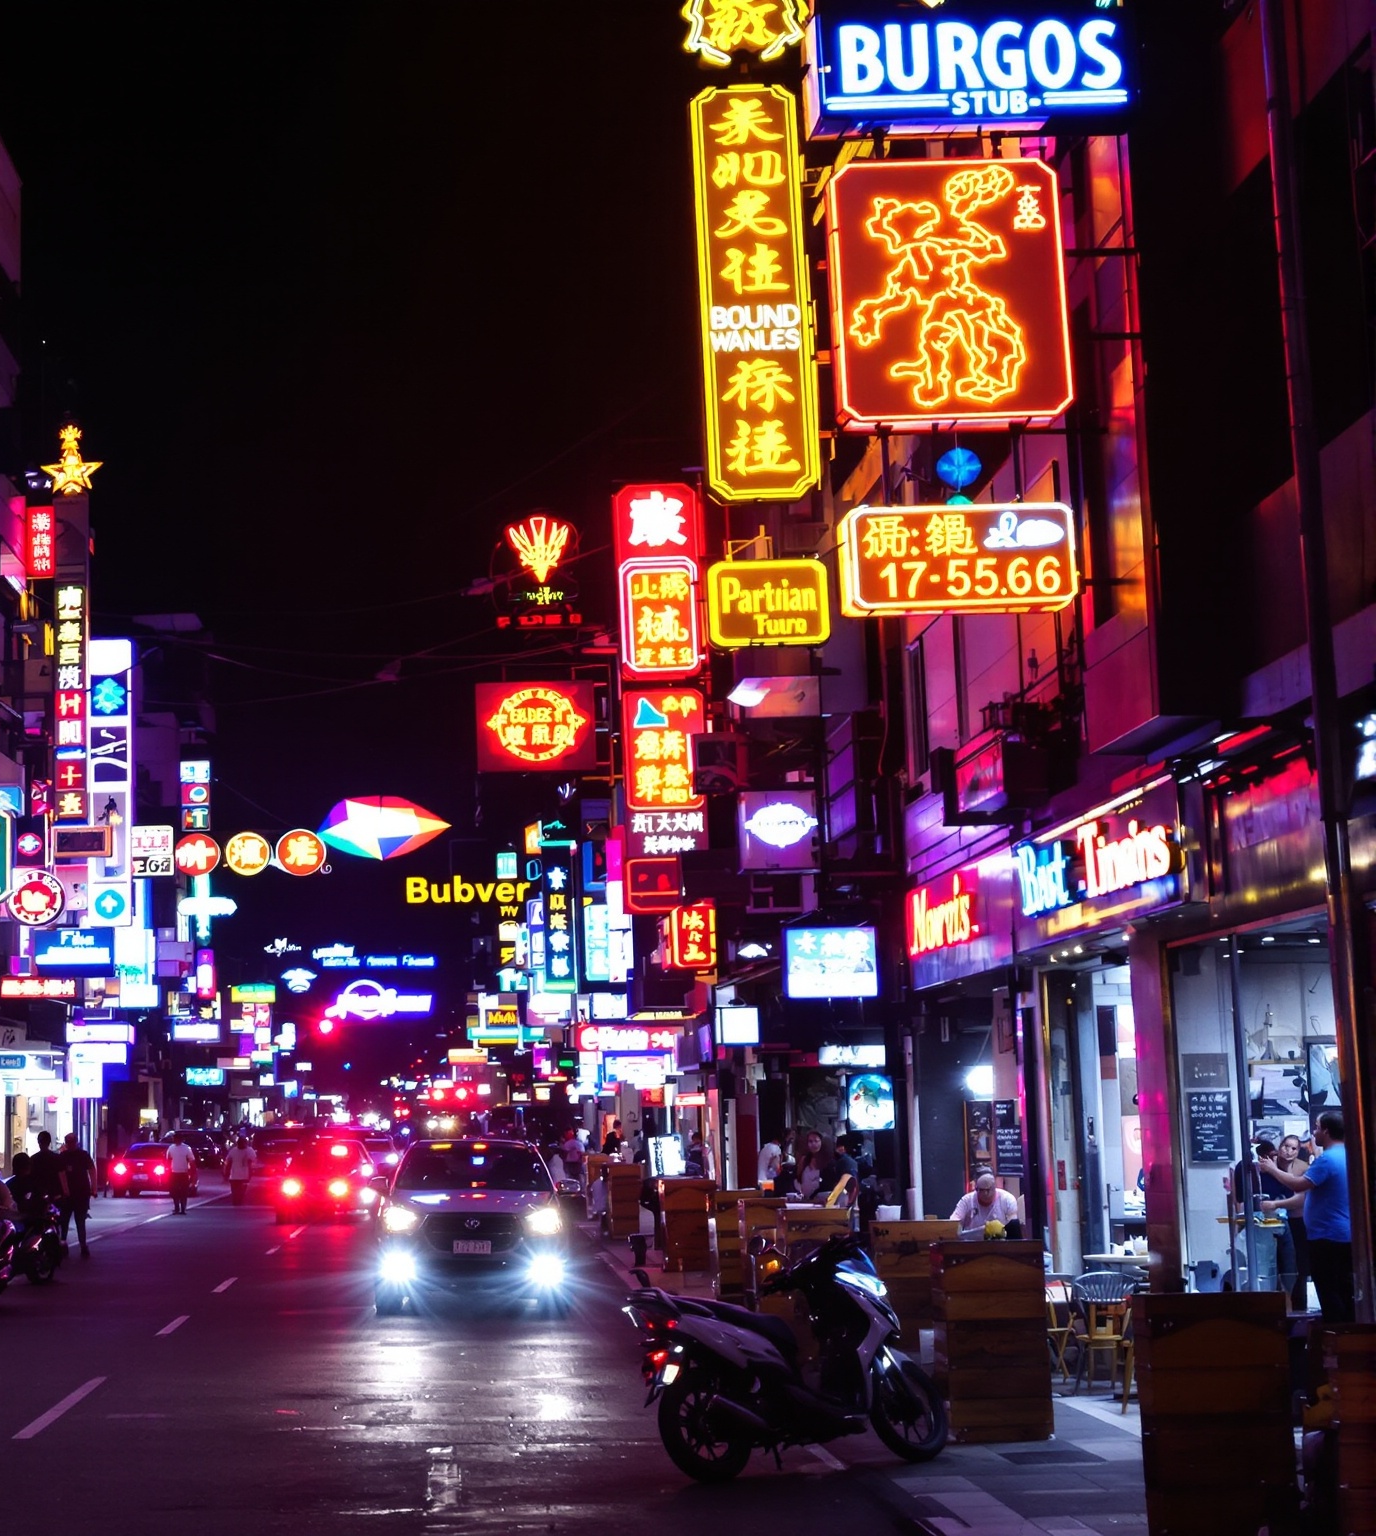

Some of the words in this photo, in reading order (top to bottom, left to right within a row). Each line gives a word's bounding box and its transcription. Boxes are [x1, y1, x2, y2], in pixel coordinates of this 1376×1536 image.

[838, 19, 1122, 93] BURGOS
[710, 304, 801, 331] BOUND
[710, 329, 801, 352] WANLES
[880, 556, 1061, 598] 17-55.66
[406, 875, 531, 904] Bubver
